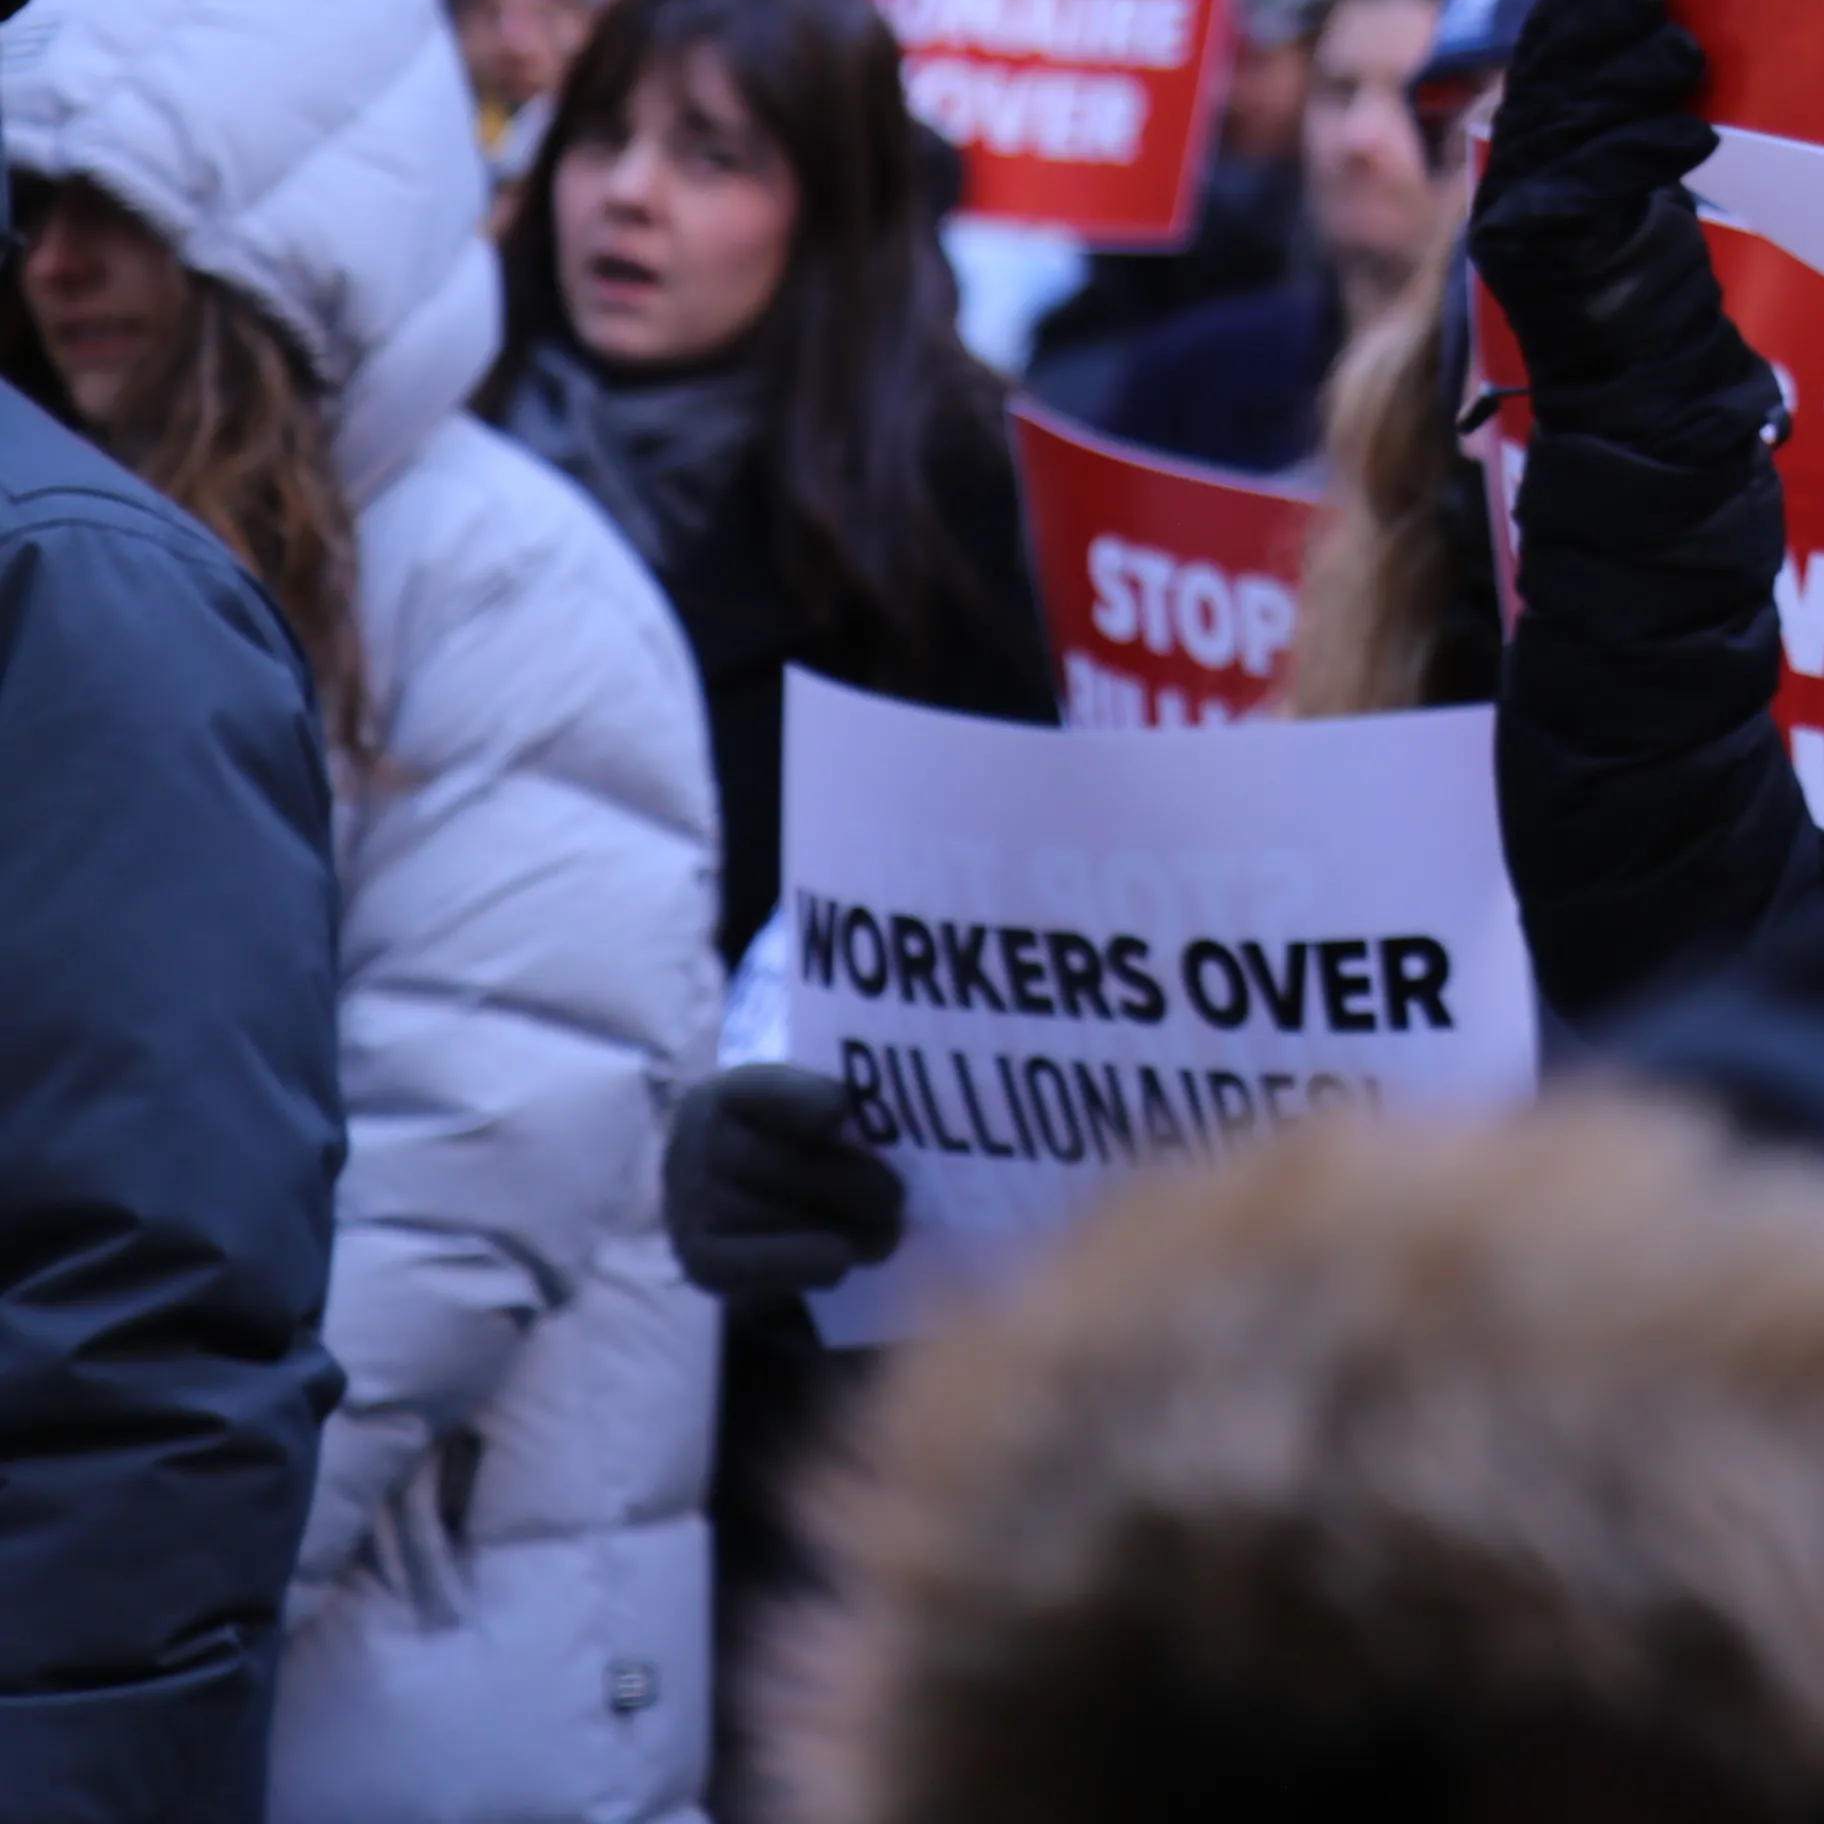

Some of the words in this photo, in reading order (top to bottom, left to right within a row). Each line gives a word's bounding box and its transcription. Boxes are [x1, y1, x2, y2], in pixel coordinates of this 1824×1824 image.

[1086, 534, 1298, 678] STOP
[798, 888, 1168, 1026] WORKERS
[1180, 934, 1454, 1034] OVER
